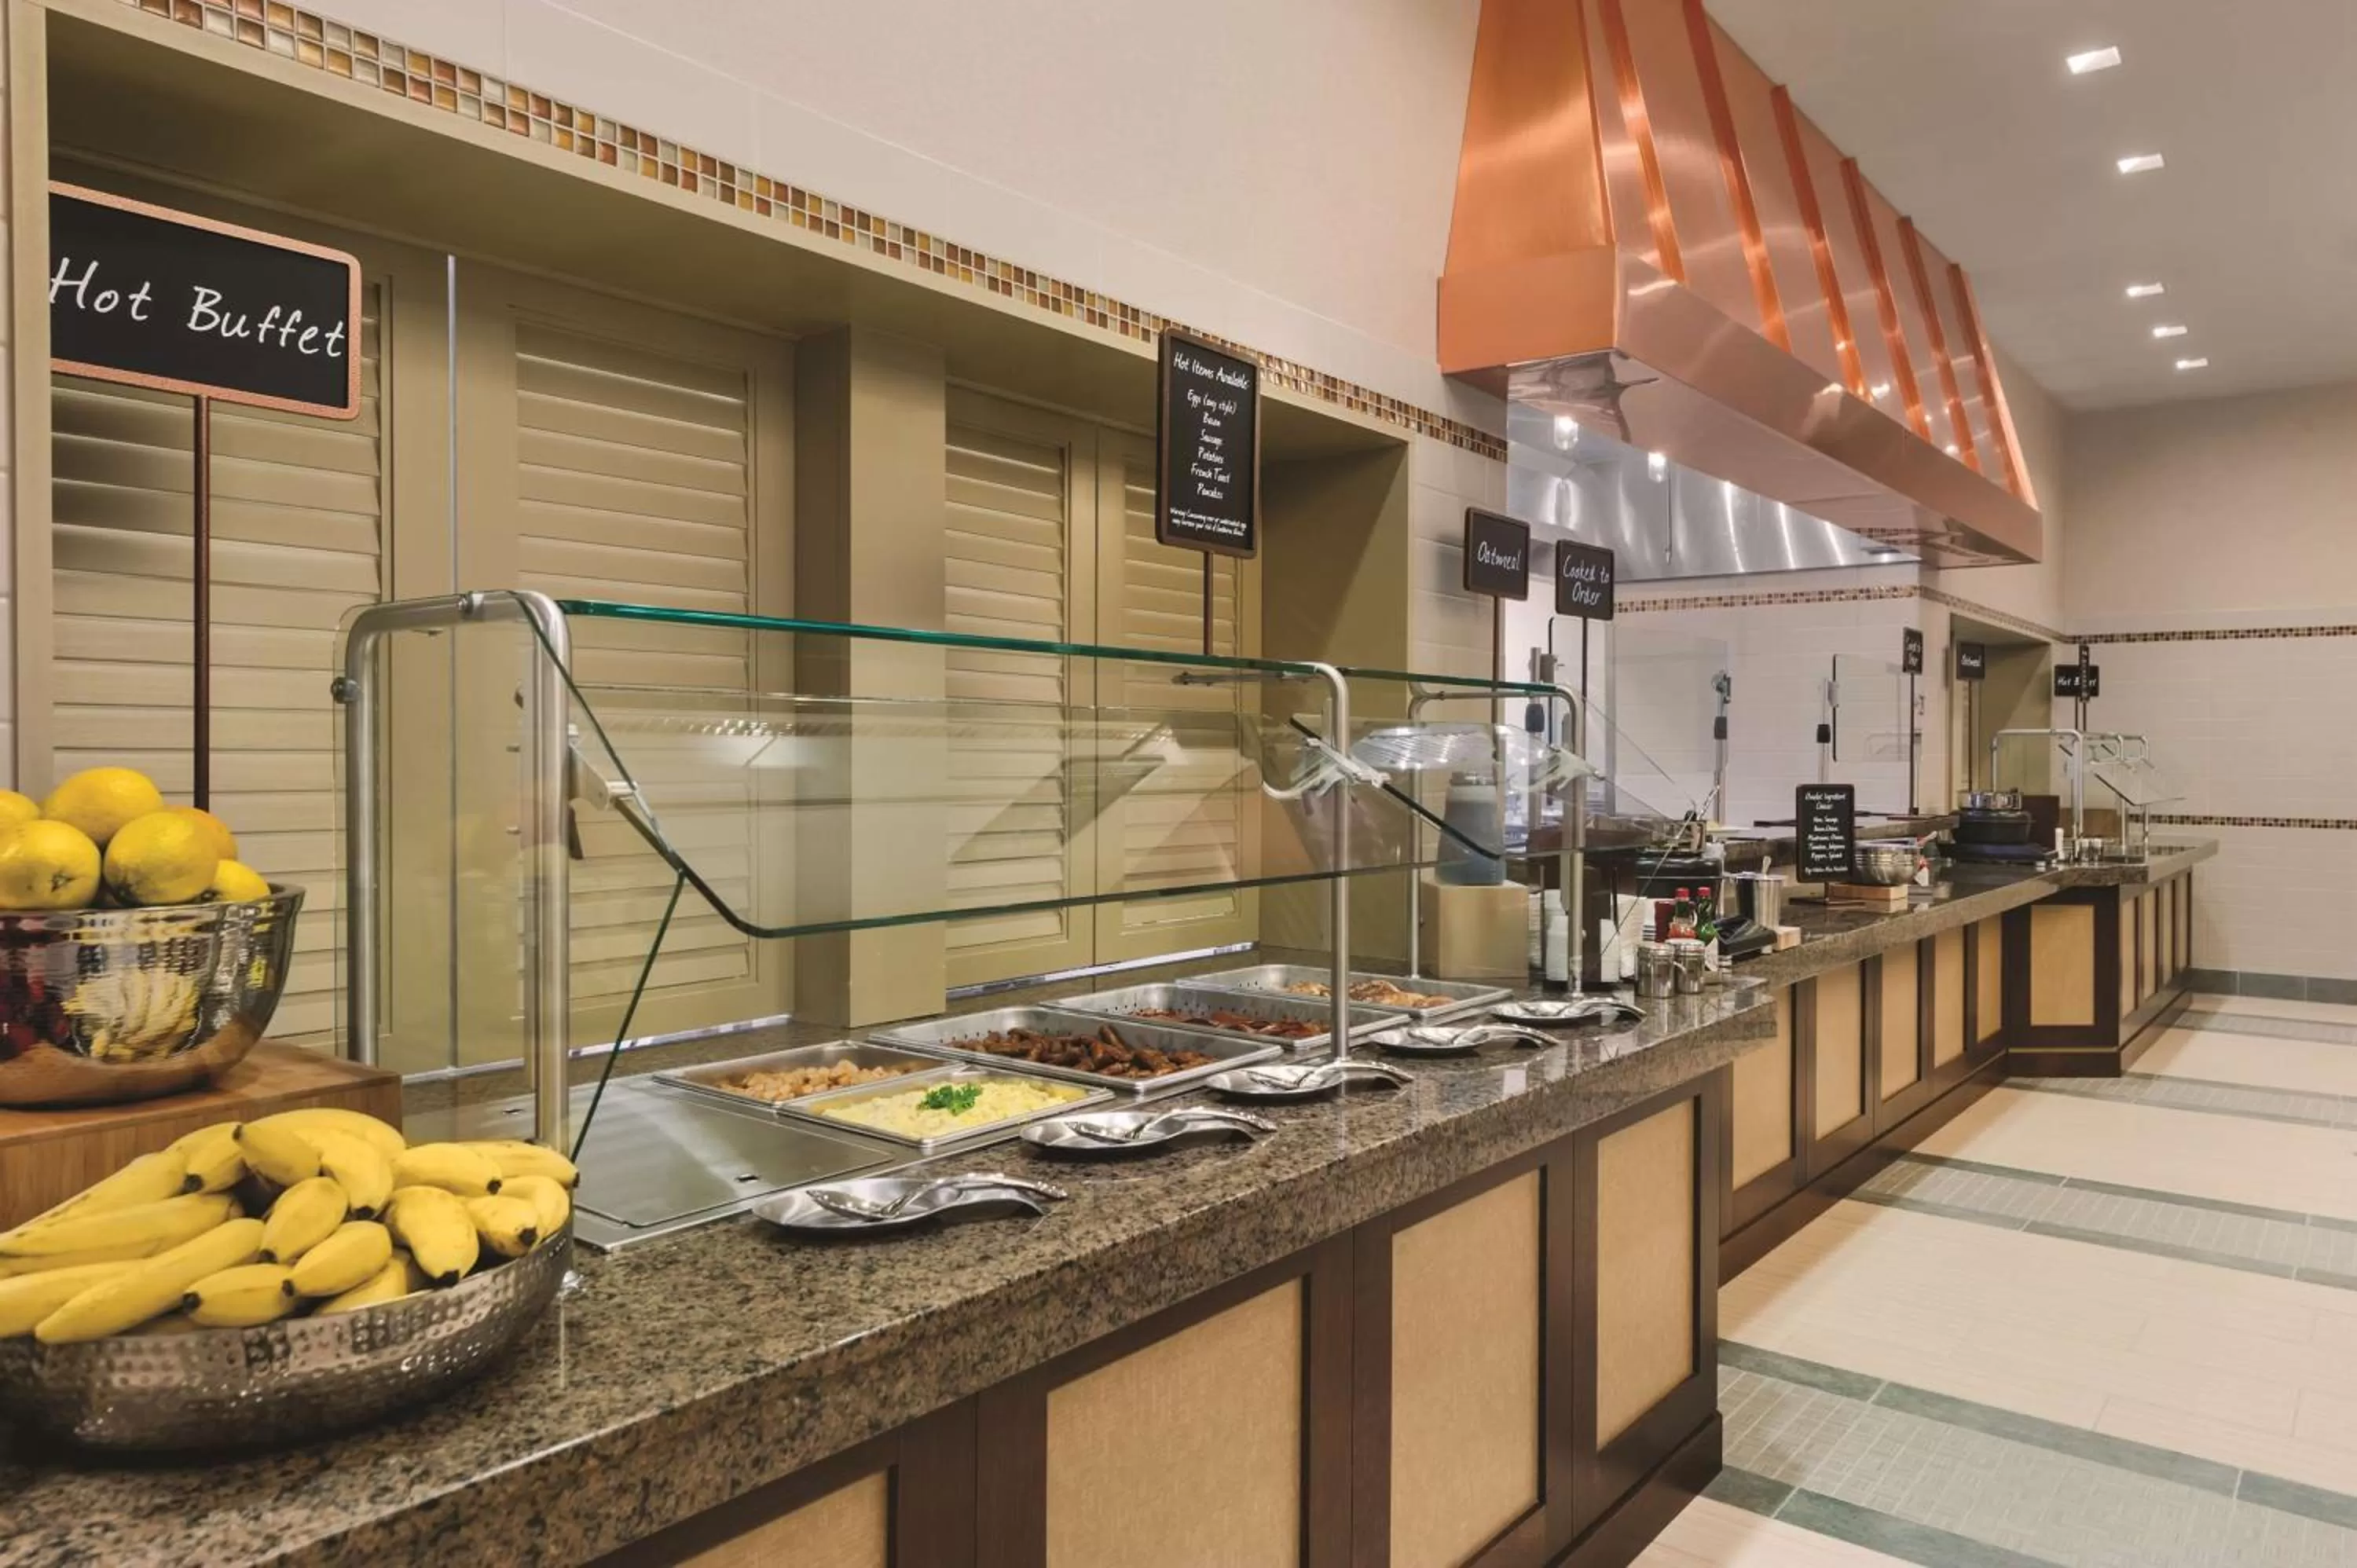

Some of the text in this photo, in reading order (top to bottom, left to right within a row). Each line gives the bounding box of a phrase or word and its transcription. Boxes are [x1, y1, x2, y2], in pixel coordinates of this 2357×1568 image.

[49, 256, 345, 357] Hot Buffet
[1173, 351, 1189, 372] Hot
[1192, 359, 1214, 379] Items
[1187, 389, 1201, 408] Eggs
[1203, 394, 1217, 412] (any
[1203, 412, 1221, 427] Bacon
[1190, 463, 1212, 479] French
[1477, 540, 1522, 571] Oatmeal
[1563, 555, 1610, 584] Cooked to
[1571, 581, 1602, 606] Order
